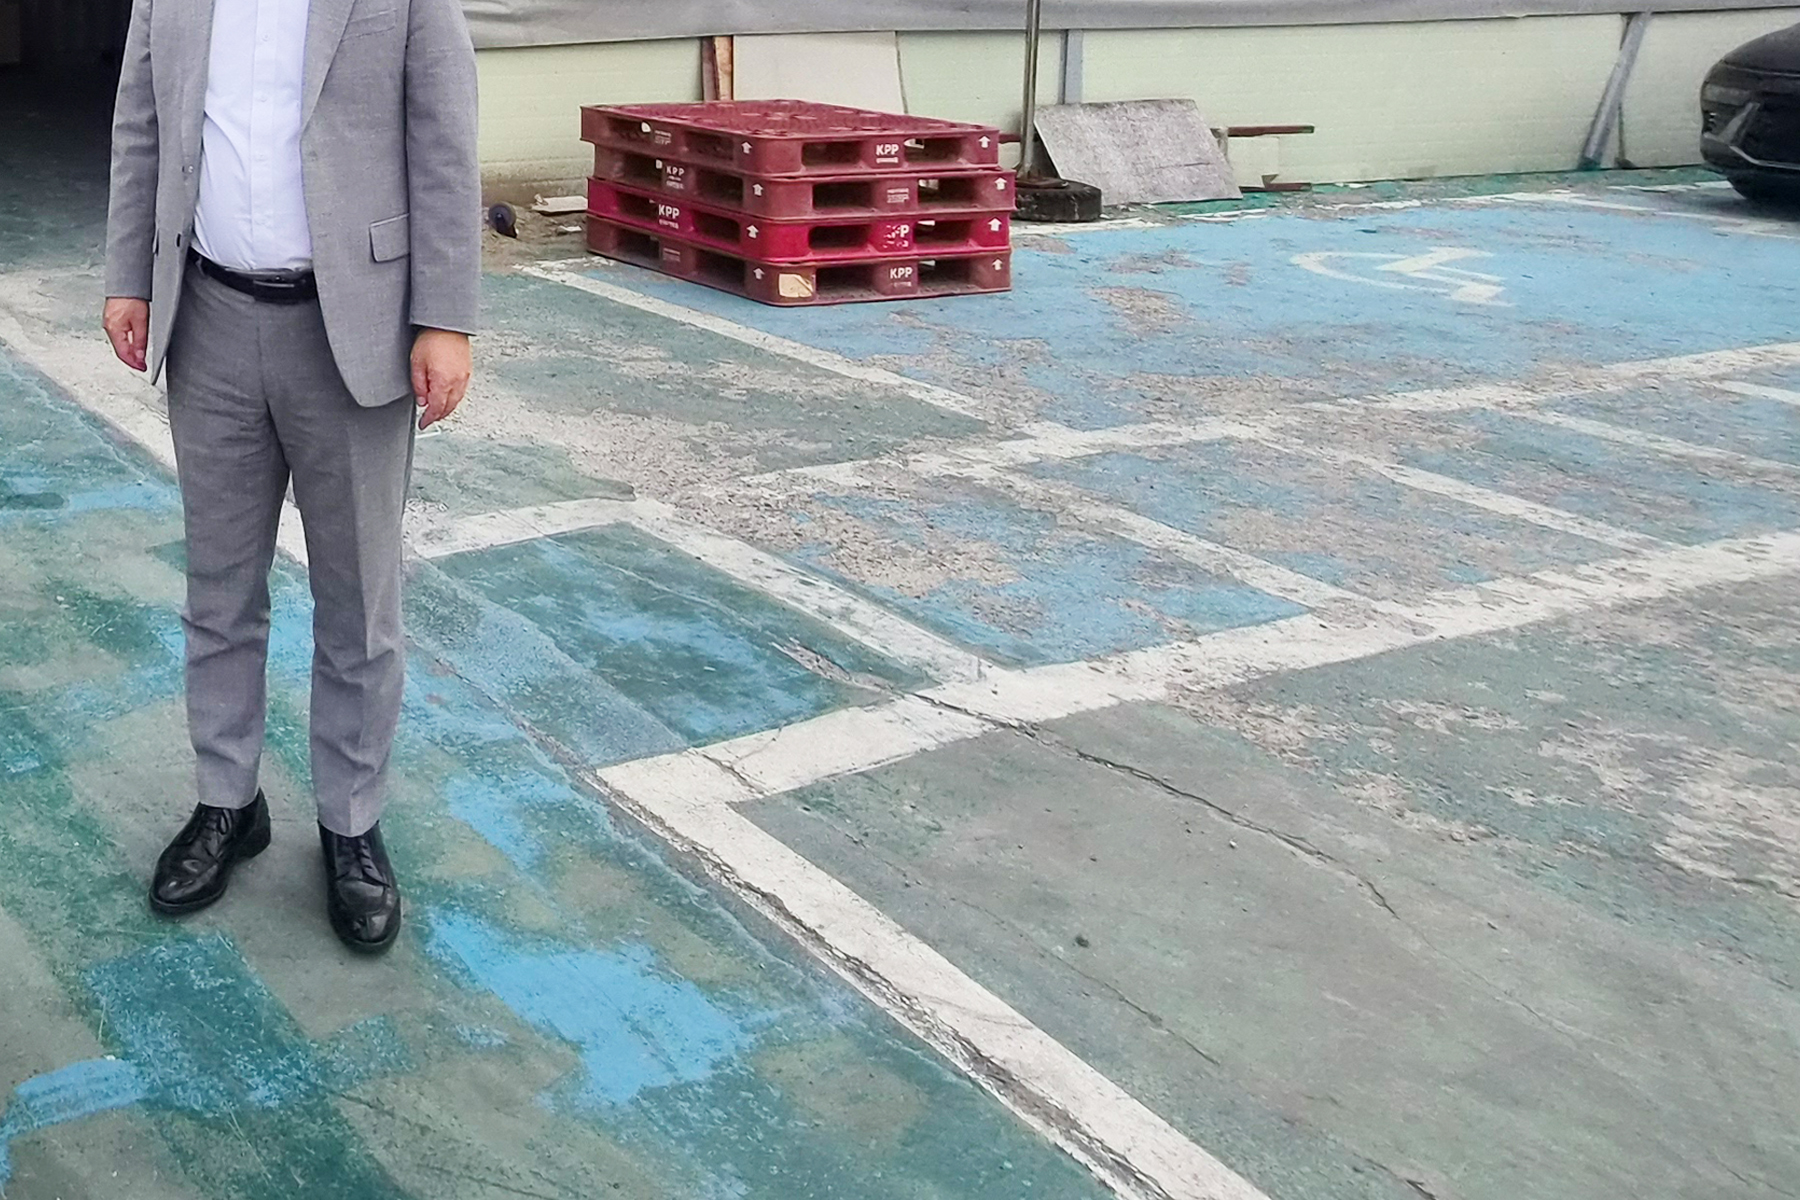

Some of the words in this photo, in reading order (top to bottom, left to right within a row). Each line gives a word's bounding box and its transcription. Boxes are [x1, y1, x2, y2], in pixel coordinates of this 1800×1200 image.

[876, 144, 900, 156] KPP
[658, 203, 680, 219] KPP
[889, 267, 913, 279] KPP
